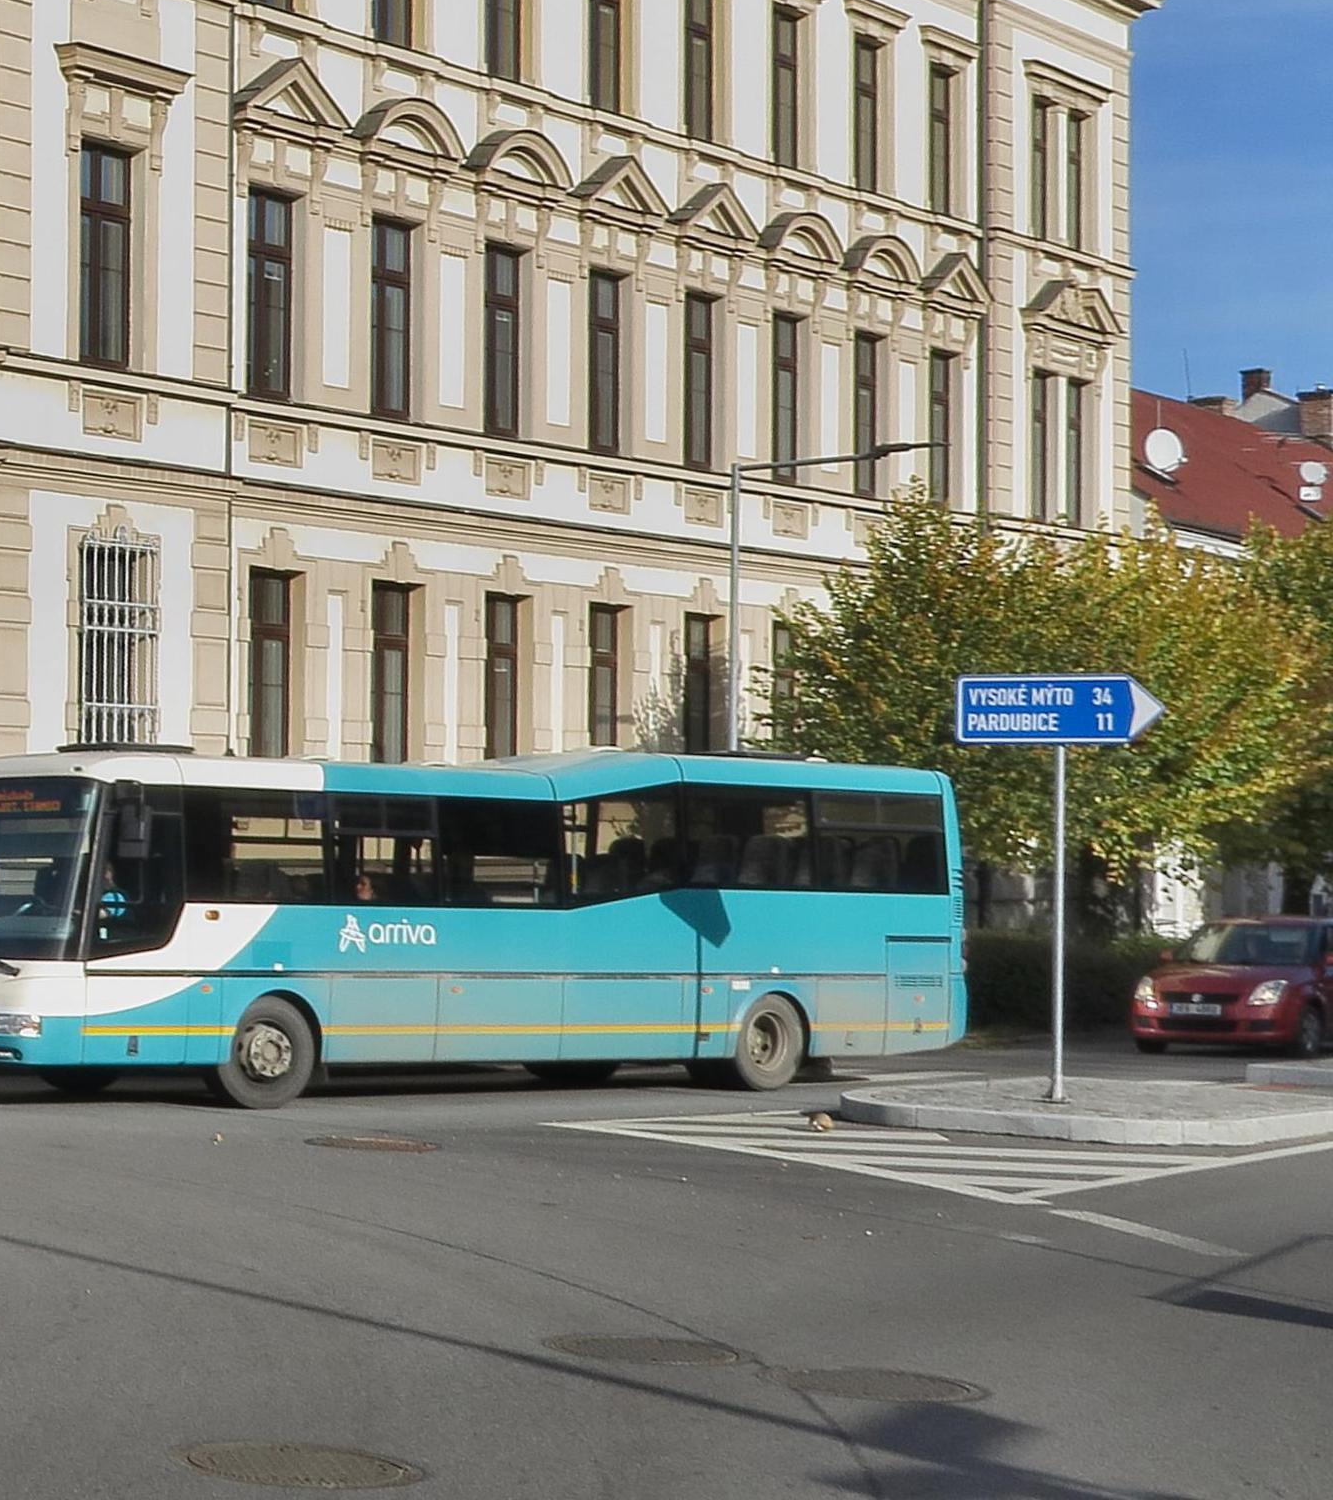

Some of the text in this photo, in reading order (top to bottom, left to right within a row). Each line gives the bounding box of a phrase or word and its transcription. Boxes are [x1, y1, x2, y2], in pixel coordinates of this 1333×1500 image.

[968, 683, 1113, 706] VYSOKÉ MÝTO 34
[967, 713, 1113, 731] PARDUBICE 11
[368, 918, 437, 945] arriva
